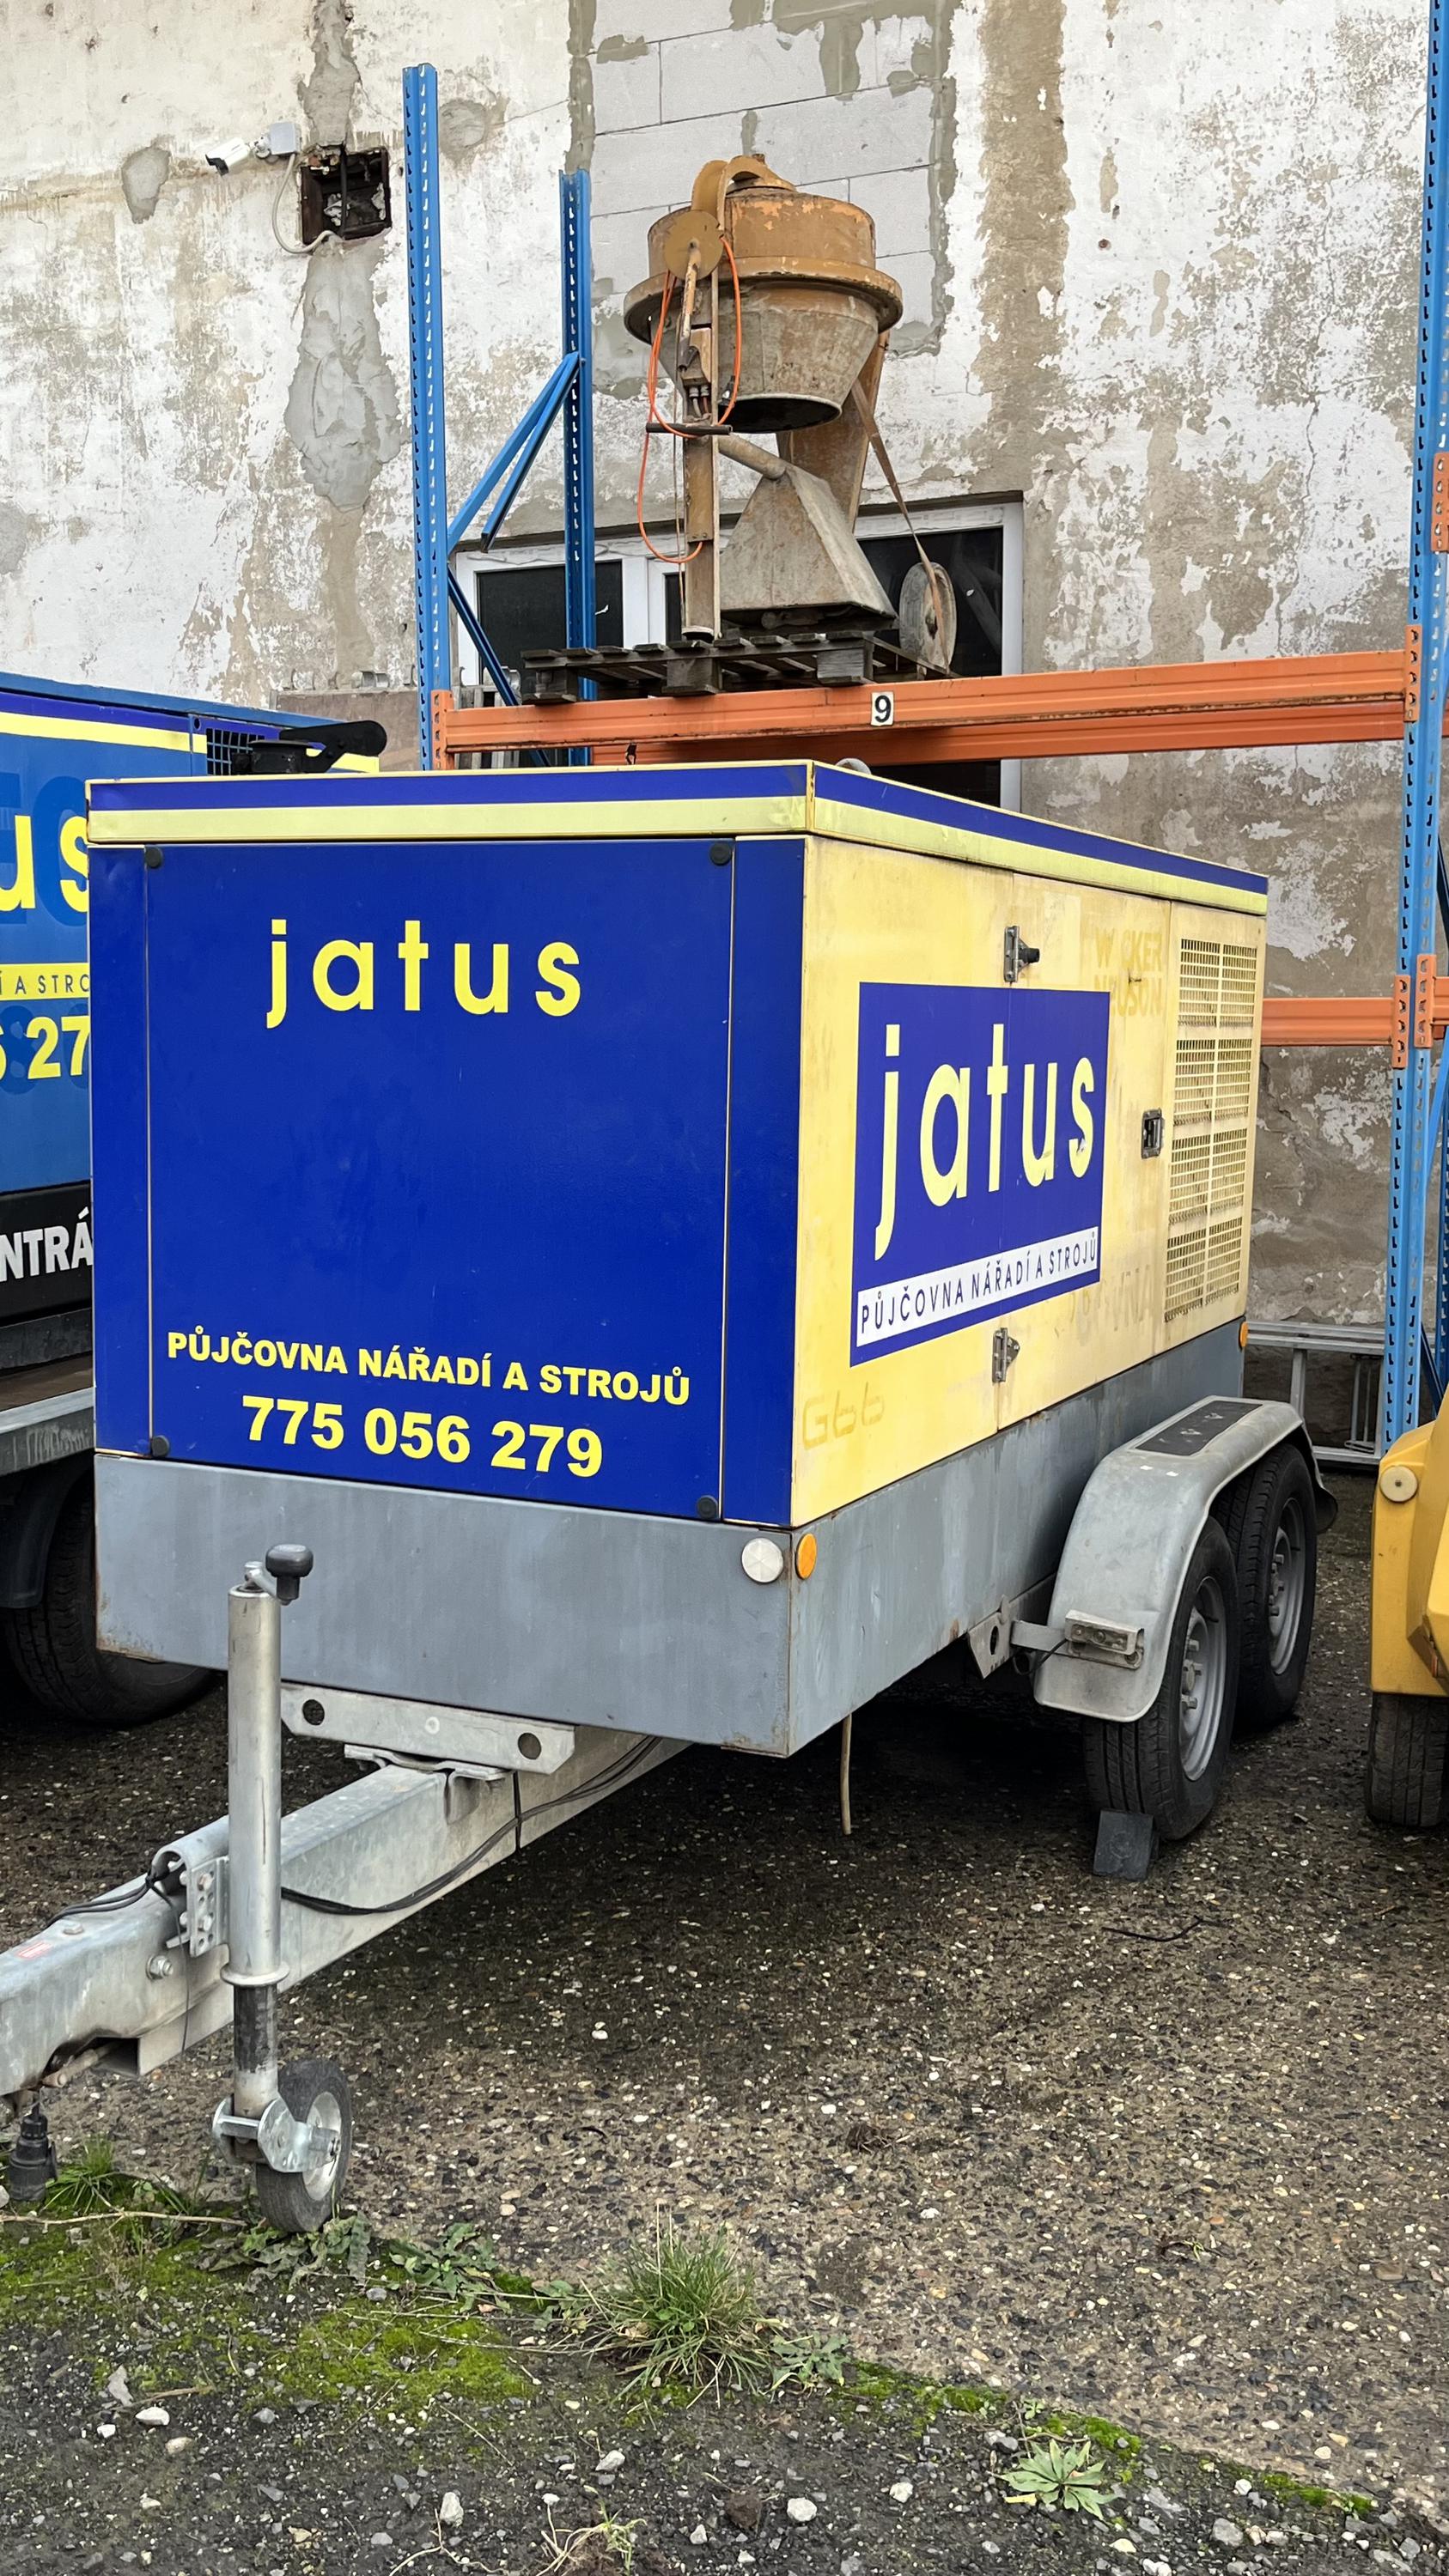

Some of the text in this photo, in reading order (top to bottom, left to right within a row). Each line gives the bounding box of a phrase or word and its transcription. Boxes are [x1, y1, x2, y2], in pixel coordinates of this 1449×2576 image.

[874, 695, 892, 723] 9
[265, 918, 581, 1029] jatus
[874, 1023, 1095, 1261] jatus
[861, 1230, 1097, 1334] PŮJČOVNA NÁŘADÍ A STROJŮ
[167, 1325, 690, 1406] PŮJČOVNA NÁŘADÍ A STROJŮ
[242, 1394, 603, 1478] 775 056 279
